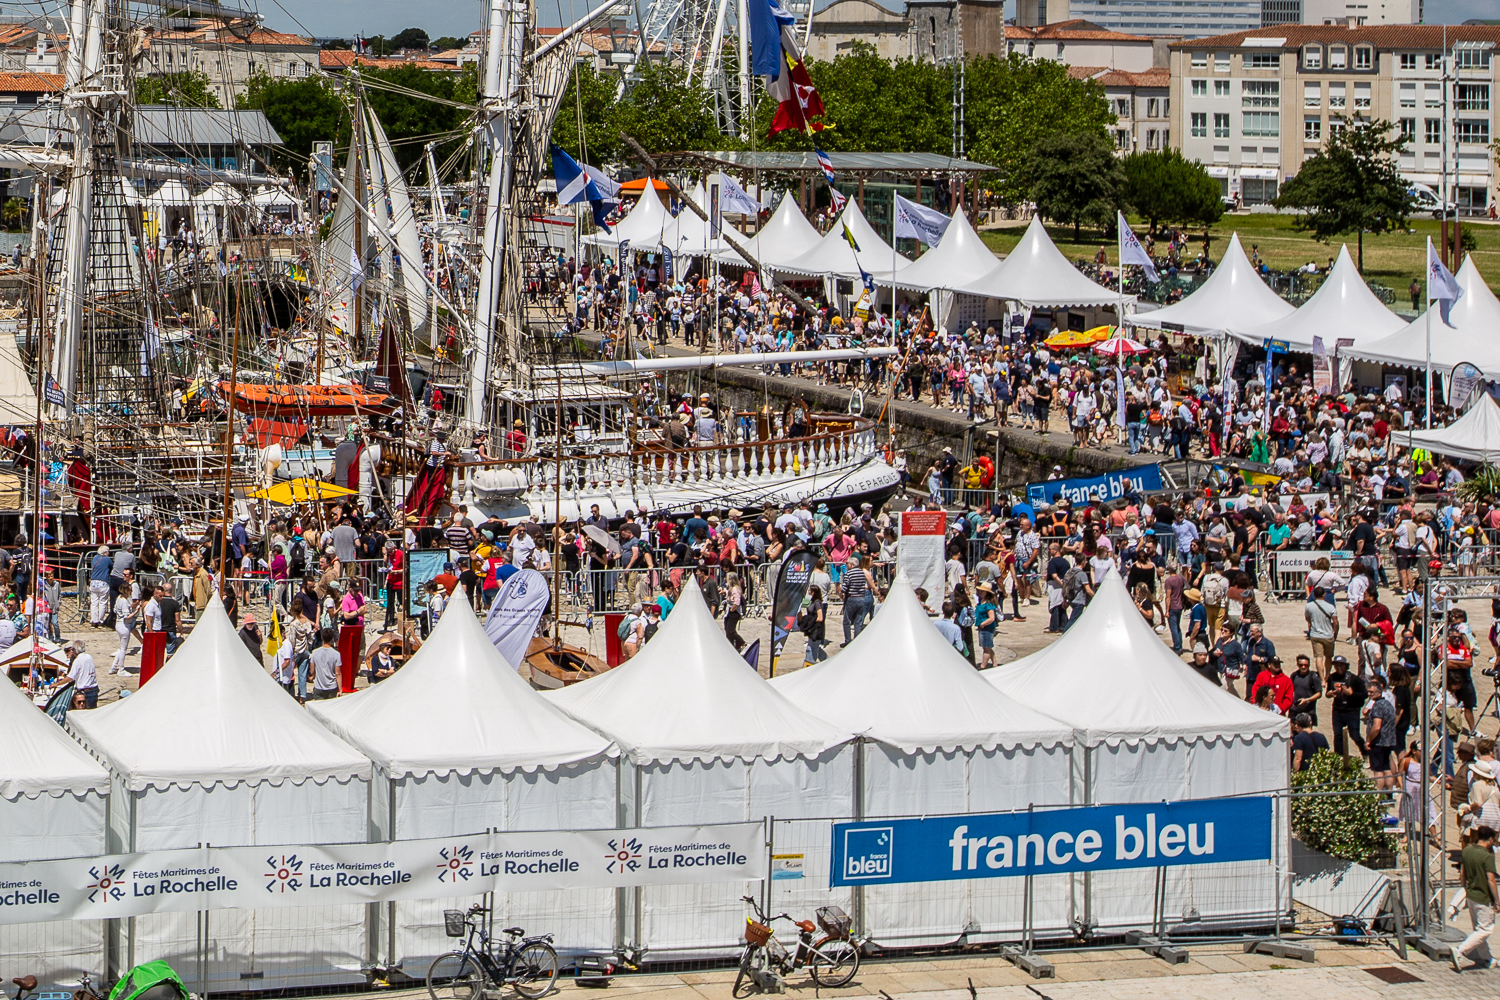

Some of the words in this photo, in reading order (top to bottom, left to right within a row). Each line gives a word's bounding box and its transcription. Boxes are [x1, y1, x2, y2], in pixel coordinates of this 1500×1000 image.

[847, 472, 898, 494] D'EPARGNE
[649, 844, 673, 853] Fêtes
[674, 842, 717, 852] Maritimes
[719, 841, 731, 850] de
[949, 825, 1102, 871] france
[1115, 813, 1215, 860] bleu
[481, 851, 505, 859] Fêtes
[506, 849, 550, 858] Maritimes
[552, 848, 563, 856] de
[648, 855, 669, 869] La
[674, 852, 747, 867] Rochelle
[133, 870, 159, 879] Fêtes
[160, 867, 206, 877] Maritimes
[208, 866, 220, 874] de
[310, 862, 334, 871] Fêtes
[336, 861, 381, 870] Maritimes
[383, 860, 395, 868] de
[481, 862, 500, 877] La
[505, 859, 579, 875] Rochelle
[848, 855, 888, 875] bleu
[28, 879, 42, 887] de
[133, 882, 155, 897] La
[160, 876, 238, 894] Rochelle
[310, 873, 331, 888] La
[336, 870, 412, 886] Rochelle
